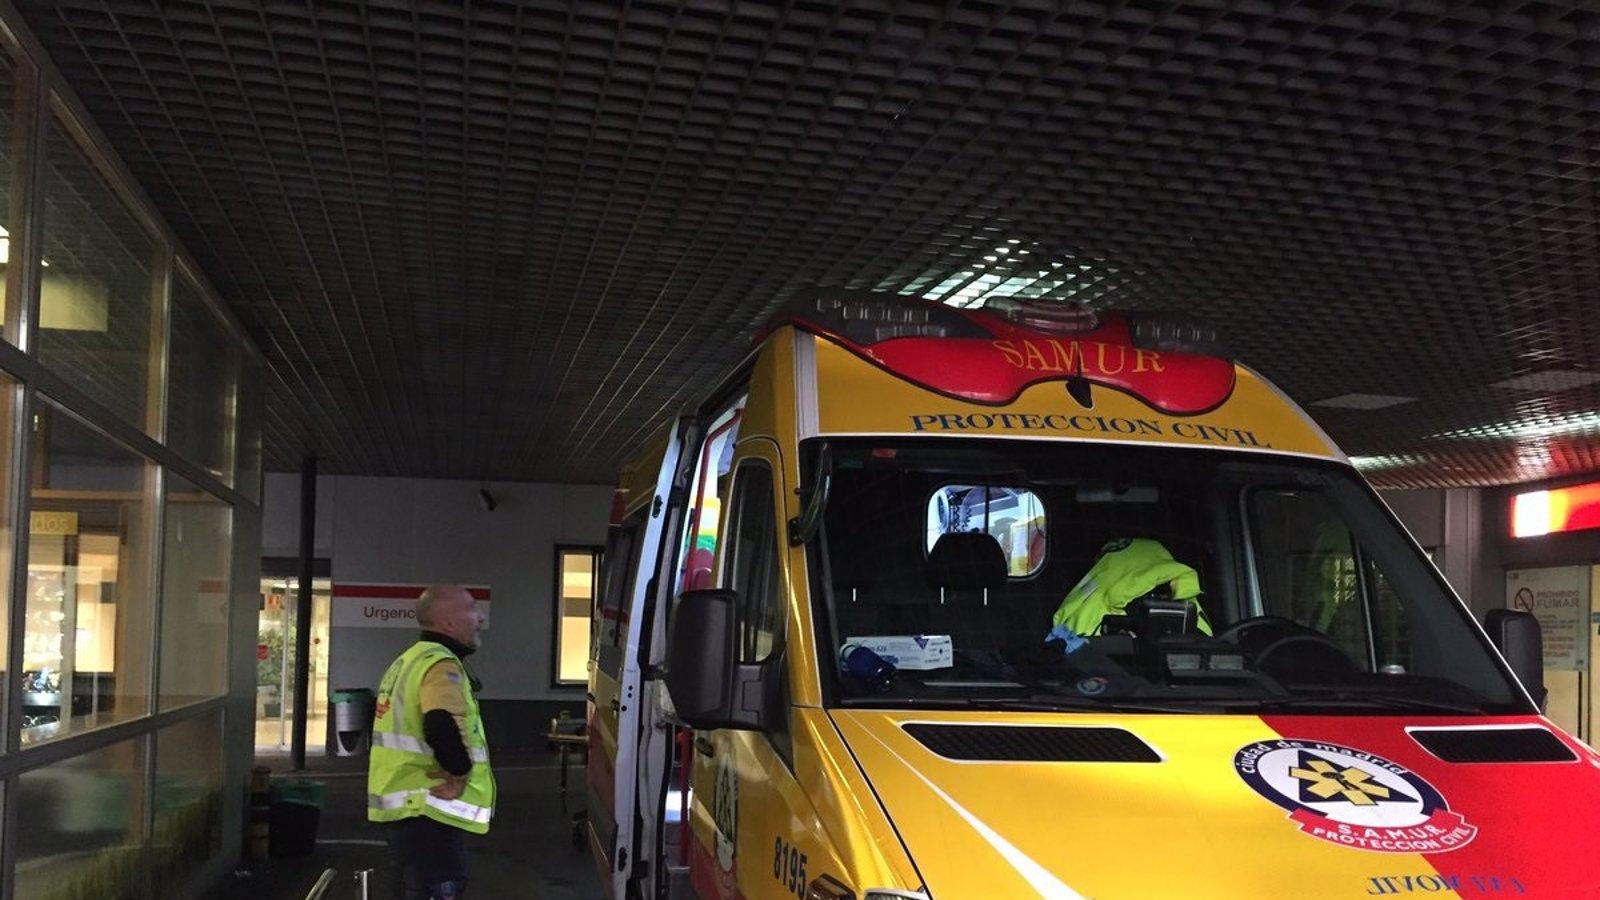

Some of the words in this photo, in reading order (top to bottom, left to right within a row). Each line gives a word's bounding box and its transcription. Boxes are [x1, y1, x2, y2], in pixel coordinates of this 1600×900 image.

[991, 339, 1165, 375] SAMUR
[909, 413, 1163, 434] PROTECCION
[1171, 422, 1273, 448] CIVIL
[363, 606, 417, 621] Urgenc
[1535, 598, 1580, 609] FUMAR
[1236, 741, 1272, 773] ciudad
[1277, 739, 1304, 749] de
[1315, 743, 1408, 774] madrid
[1313, 827, 1442, 851] PROTECCION
[1440, 826, 1471, 846] CIVIL
[773, 836, 808, 900] 8195
